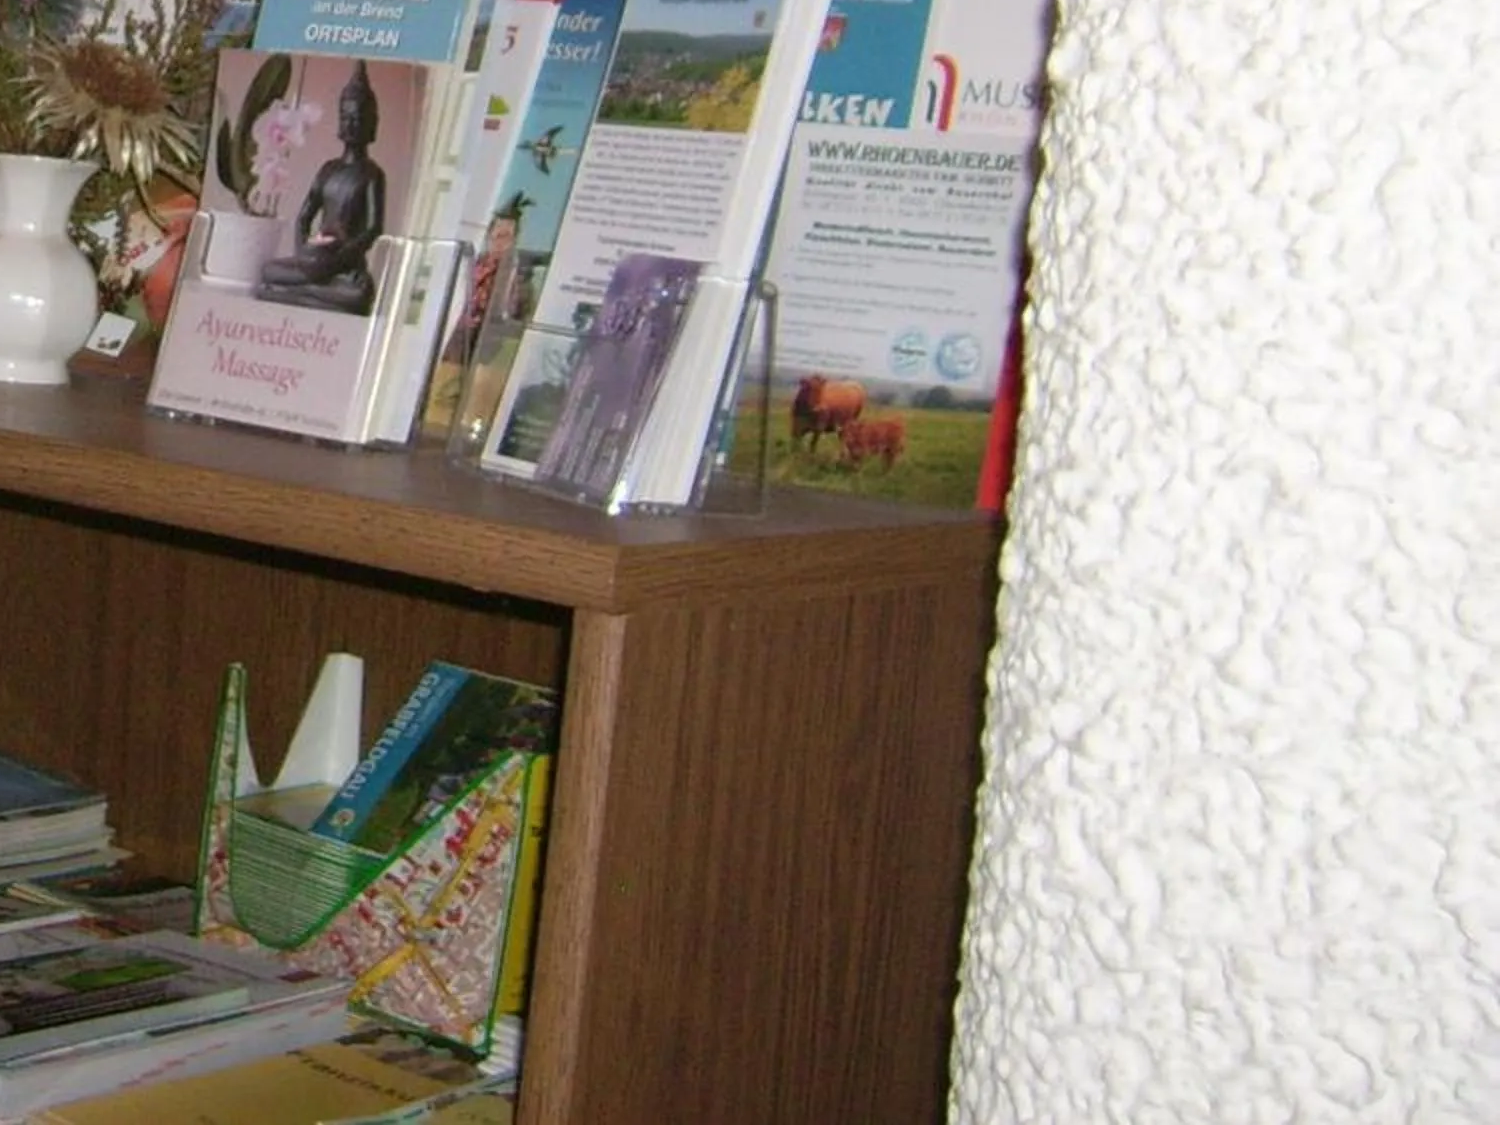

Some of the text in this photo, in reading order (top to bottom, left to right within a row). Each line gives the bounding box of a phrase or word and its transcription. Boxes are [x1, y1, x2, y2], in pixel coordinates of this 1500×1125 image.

[358, 2, 405, 21] Brend
[303, 22, 400, 48] ORTSPLAN
[196, 307, 341, 358] Ayurvedische
[210, 346, 306, 397] Massage
